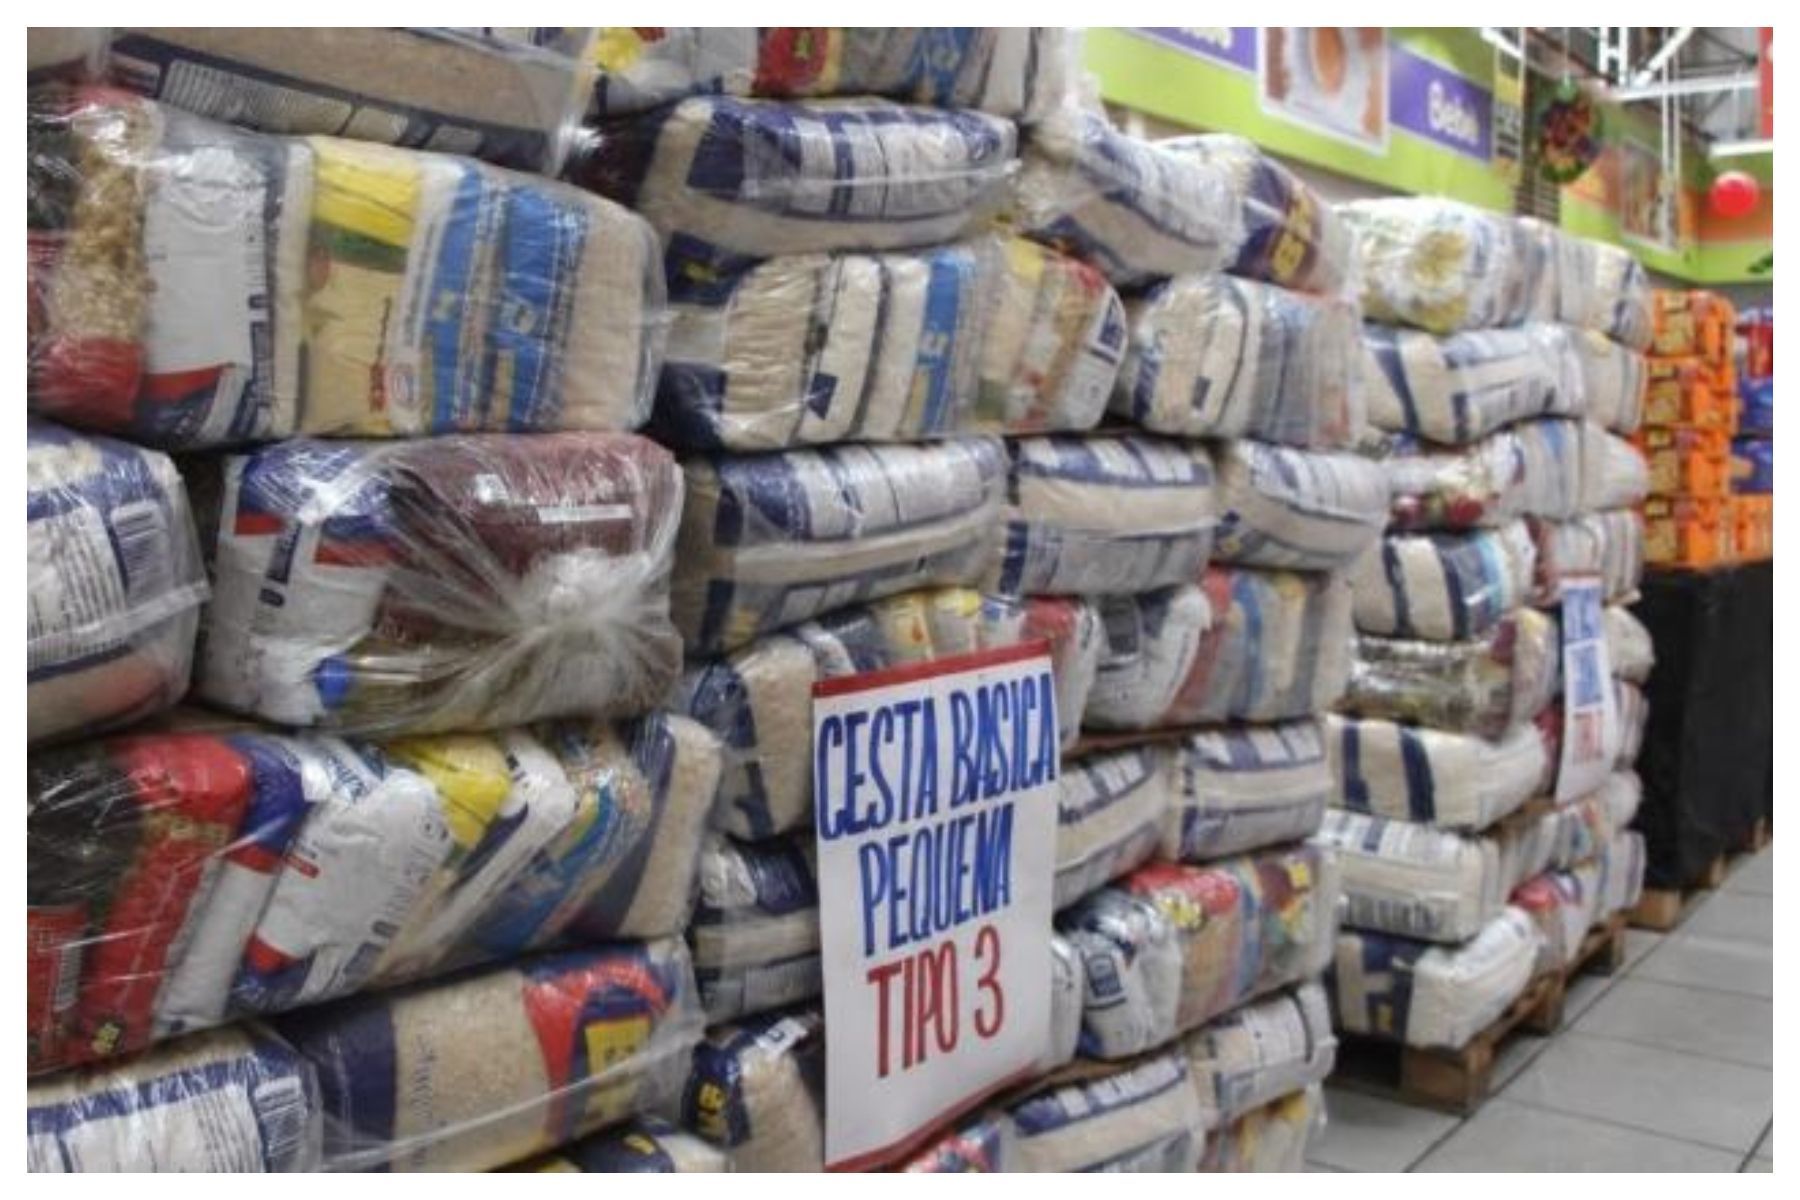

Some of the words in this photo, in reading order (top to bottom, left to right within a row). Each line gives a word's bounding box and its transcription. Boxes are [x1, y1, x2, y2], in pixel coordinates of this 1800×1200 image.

[817, 697, 939, 841] CESTA
[950, 672, 1056, 809] BASICA
[858, 803, 1014, 957] PEQUENA
[866, 940, 959, 1079] TIPO
[973, 924, 1004, 1039] 3
